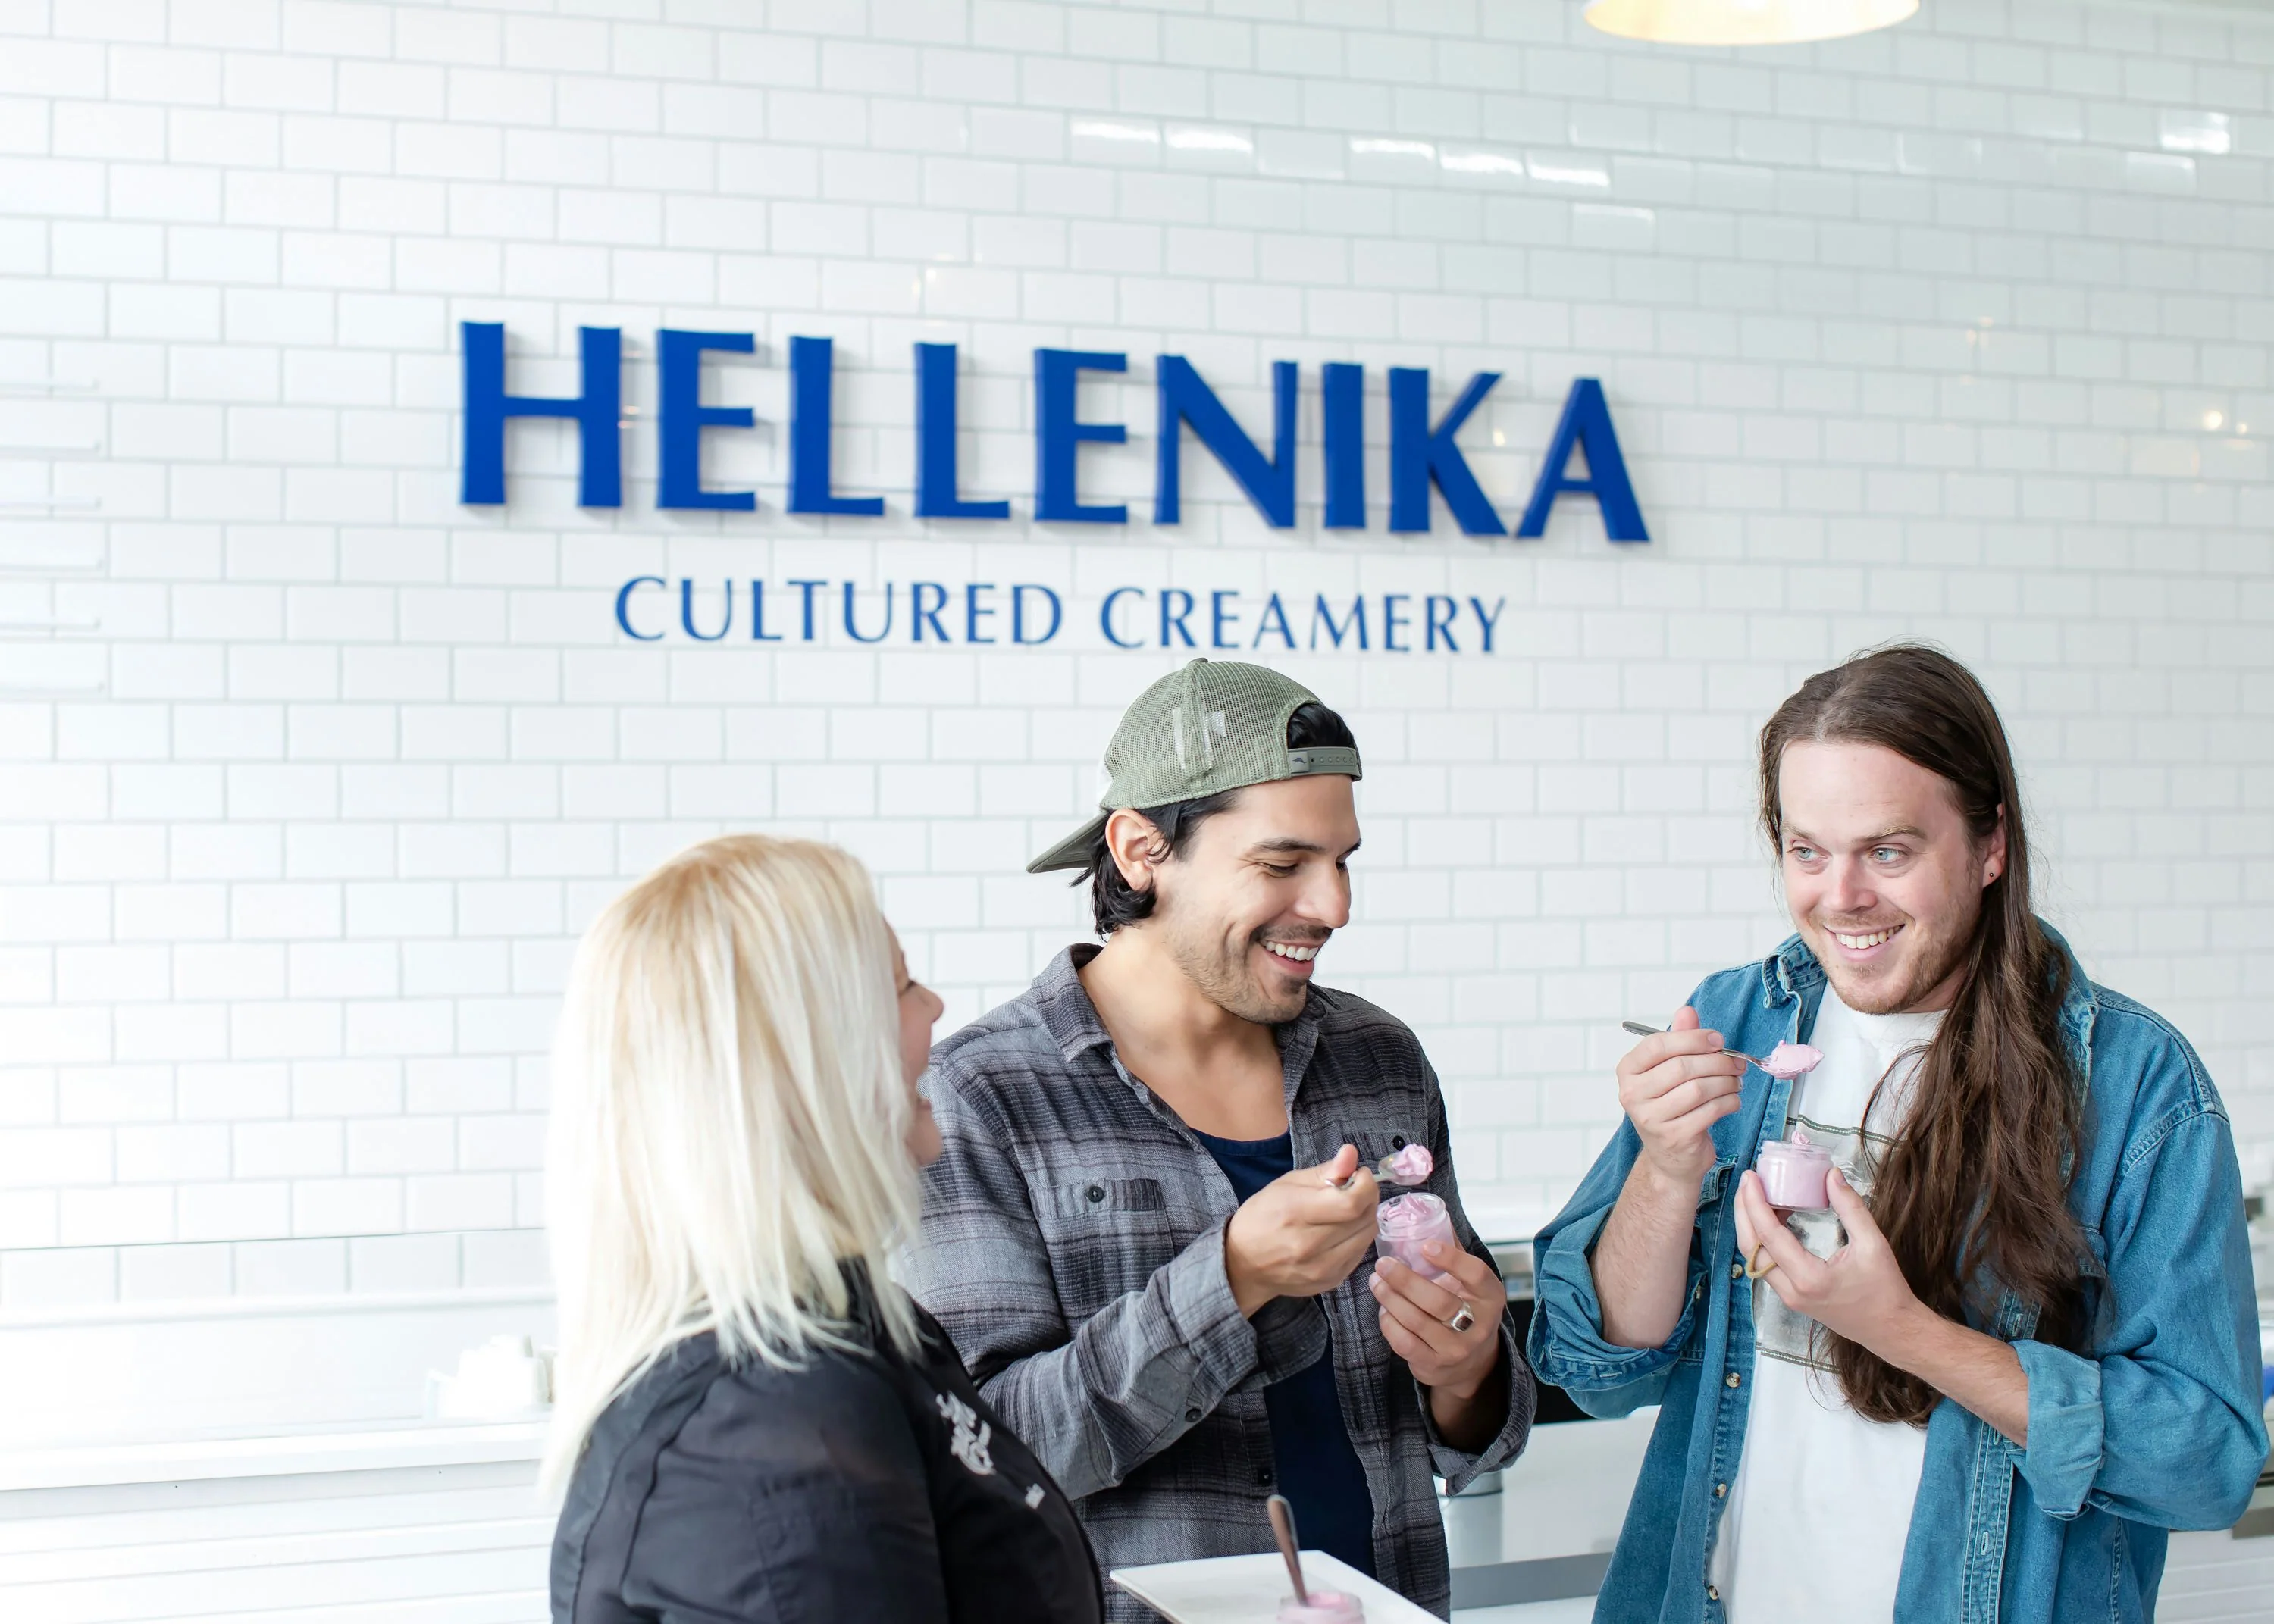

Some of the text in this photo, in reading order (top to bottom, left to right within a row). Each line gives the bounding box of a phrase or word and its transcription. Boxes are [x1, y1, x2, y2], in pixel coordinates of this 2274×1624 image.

[458, 319, 1651, 544] HELLENIKA
[613, 574, 1508, 655] CULTURED CREAMERY
